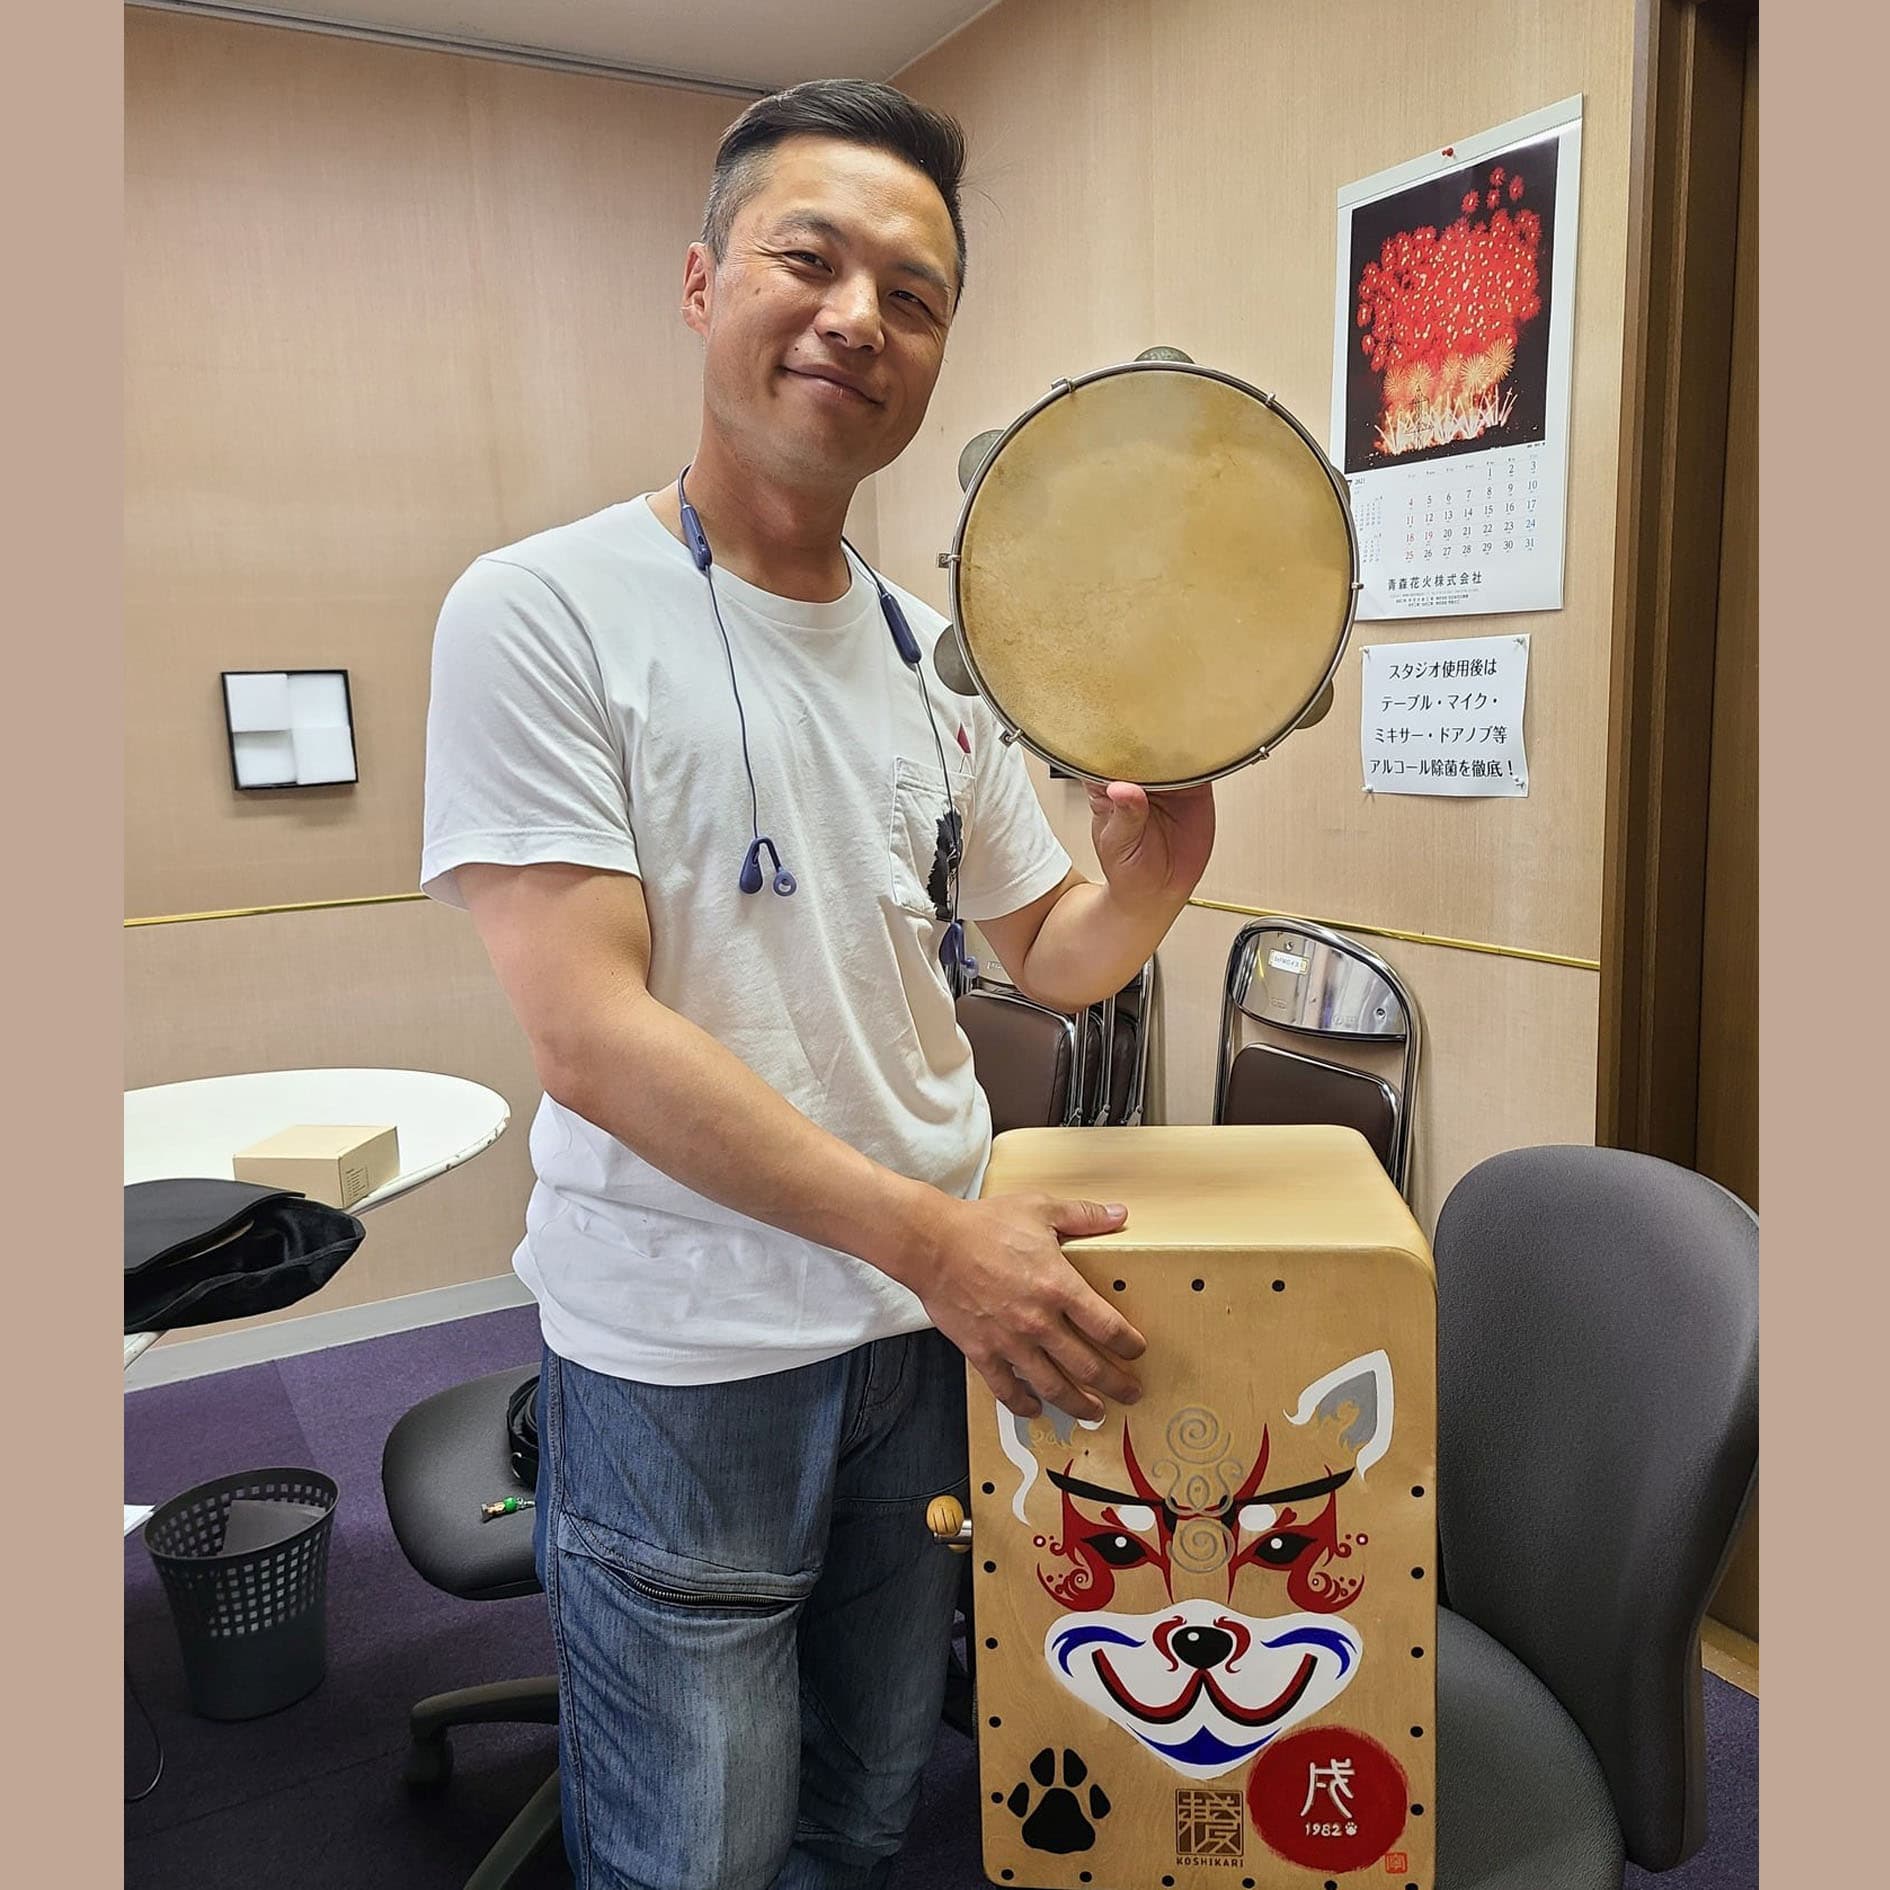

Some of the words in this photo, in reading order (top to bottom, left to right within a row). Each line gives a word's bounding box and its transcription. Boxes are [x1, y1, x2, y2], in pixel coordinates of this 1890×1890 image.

[1508, 464, 1514, 473] 2
[1530, 461, 1536, 471] 3
[1427, 495, 1432, 504] 5
[1446, 493, 1451, 501] 6
[1466, 489, 1472, 498] 7
[1486, 487, 1492, 496] 8
[1508, 483, 1513, 492] 9
[1528, 480, 1538, 490] 10
[1406, 516, 1414, 525] 11
[1425, 513, 1434, 522] 12
[1444, 510, 1453, 520] 13
[1464, 508, 1473, 517] 14
[1484, 505, 1494, 515] 15
[1505, 502, 1515, 512] 16
[1527, 500, 1537, 509] 17
[1424, 531, 1433, 540] 19
[1443, 529, 1452, 538] 20
[1462, 526, 1471, 536] 21
[1482, 524, 1493, 534] 22
[1503, 521, 1514, 531] 23
[1525, 519, 1536, 528] 24
[1405, 551, 1414, 560] 25
[1423, 549, 1433, 558] 26
[1442, 547, 1452, 556] 27
[1462, 544, 1472, 554] 28
[1482, 542, 1493, 552] 29
[1503, 540, 1514, 550] 30
[1525, 538, 1535, 547] 31
[1387, 571, 1482, 591] 青森花火株式会社
[1389, 658, 1497, 680] スタジオ使用後は
[1382, 692, 1498, 712] テーブル・マイク・
[1375, 725, 1507, 744] ミキサー・ドアノブ等
[1369, 759, 1513, 777] アルコール除菌を徹底！
[1305, 1822, 1342, 1837] 1982
[1176, 1857, 1244, 1868] KOSHIKARI
